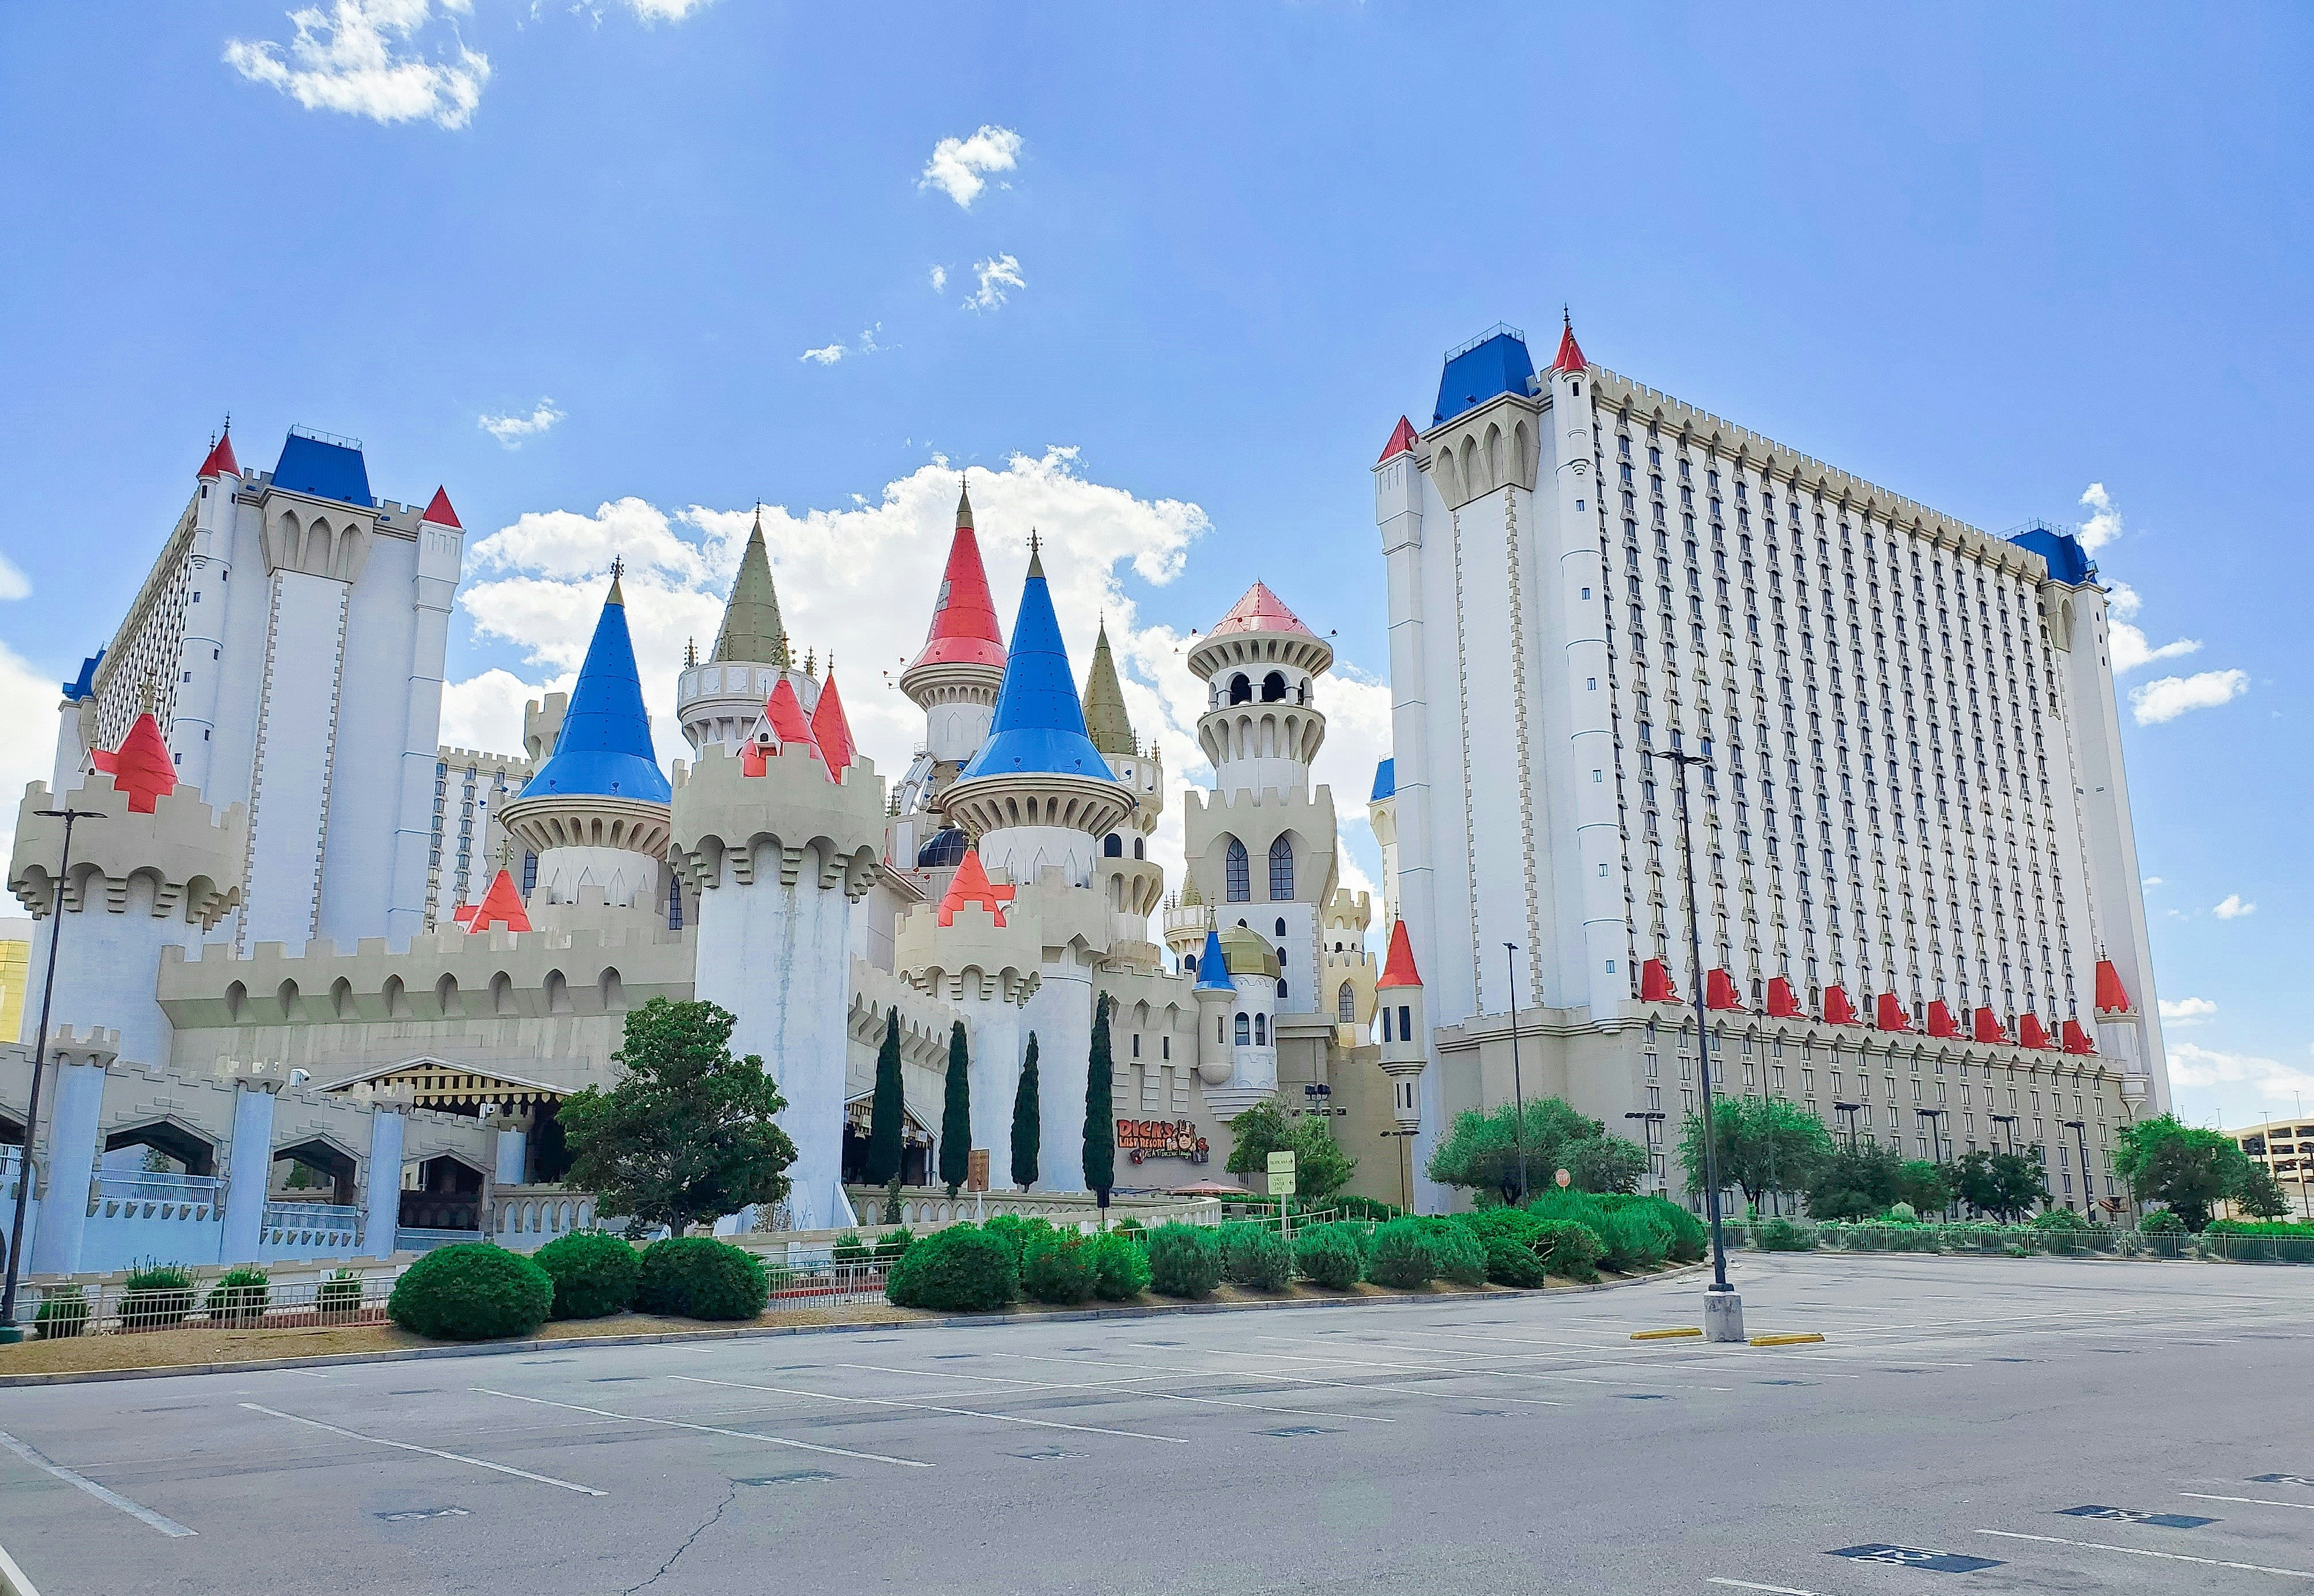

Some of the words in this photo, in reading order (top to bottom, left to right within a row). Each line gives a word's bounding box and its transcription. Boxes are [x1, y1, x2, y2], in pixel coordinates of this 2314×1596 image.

[1117, 1119, 1173, 1138] DICK'S
[1119, 1137, 1138, 1147] LAST
[1140, 1138, 1165, 1148] RESORT
[1557, 1173, 1569, 1181] STOP
